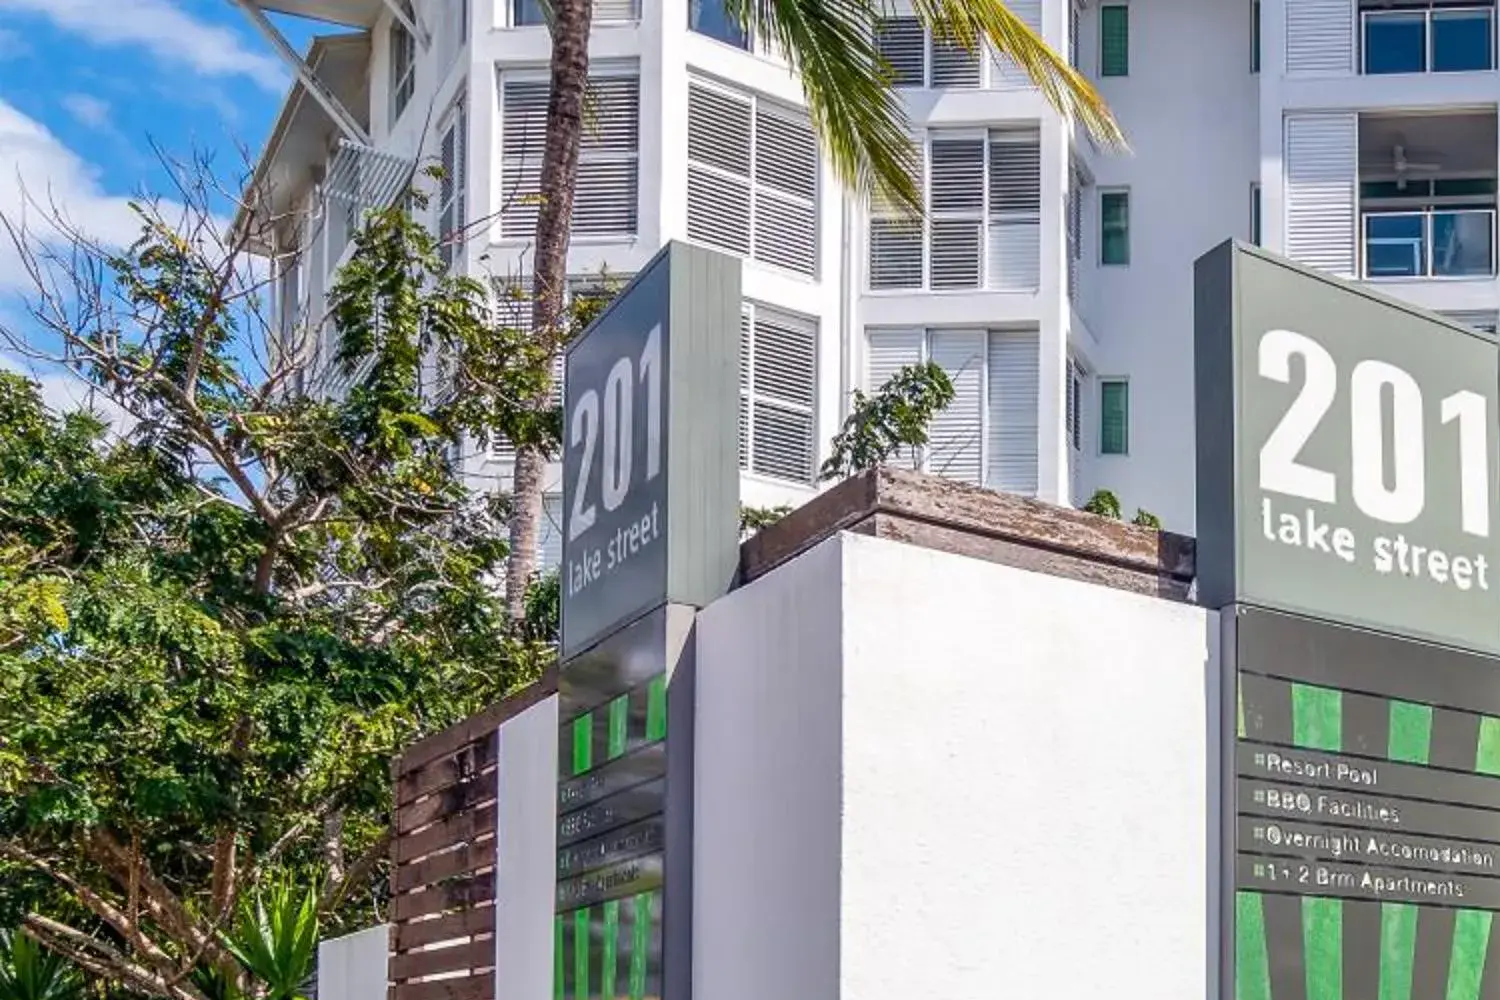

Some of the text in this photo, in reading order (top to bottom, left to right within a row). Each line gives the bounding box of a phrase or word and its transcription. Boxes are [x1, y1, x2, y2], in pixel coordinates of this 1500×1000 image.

[569, 322, 661, 542] 201
[1258, 329, 1489, 537] 201
[569, 502, 659, 597] lake street
[1262, 497, 1489, 590] lake street
[1267, 753, 1377, 785] Resort Pool
[1267, 789, 1400, 823] BBQ Facilities
[1267, 825, 1360, 855] Overnight
[1299, 865, 1309, 883] 2
[1361, 871, 1464, 896] Apartments
